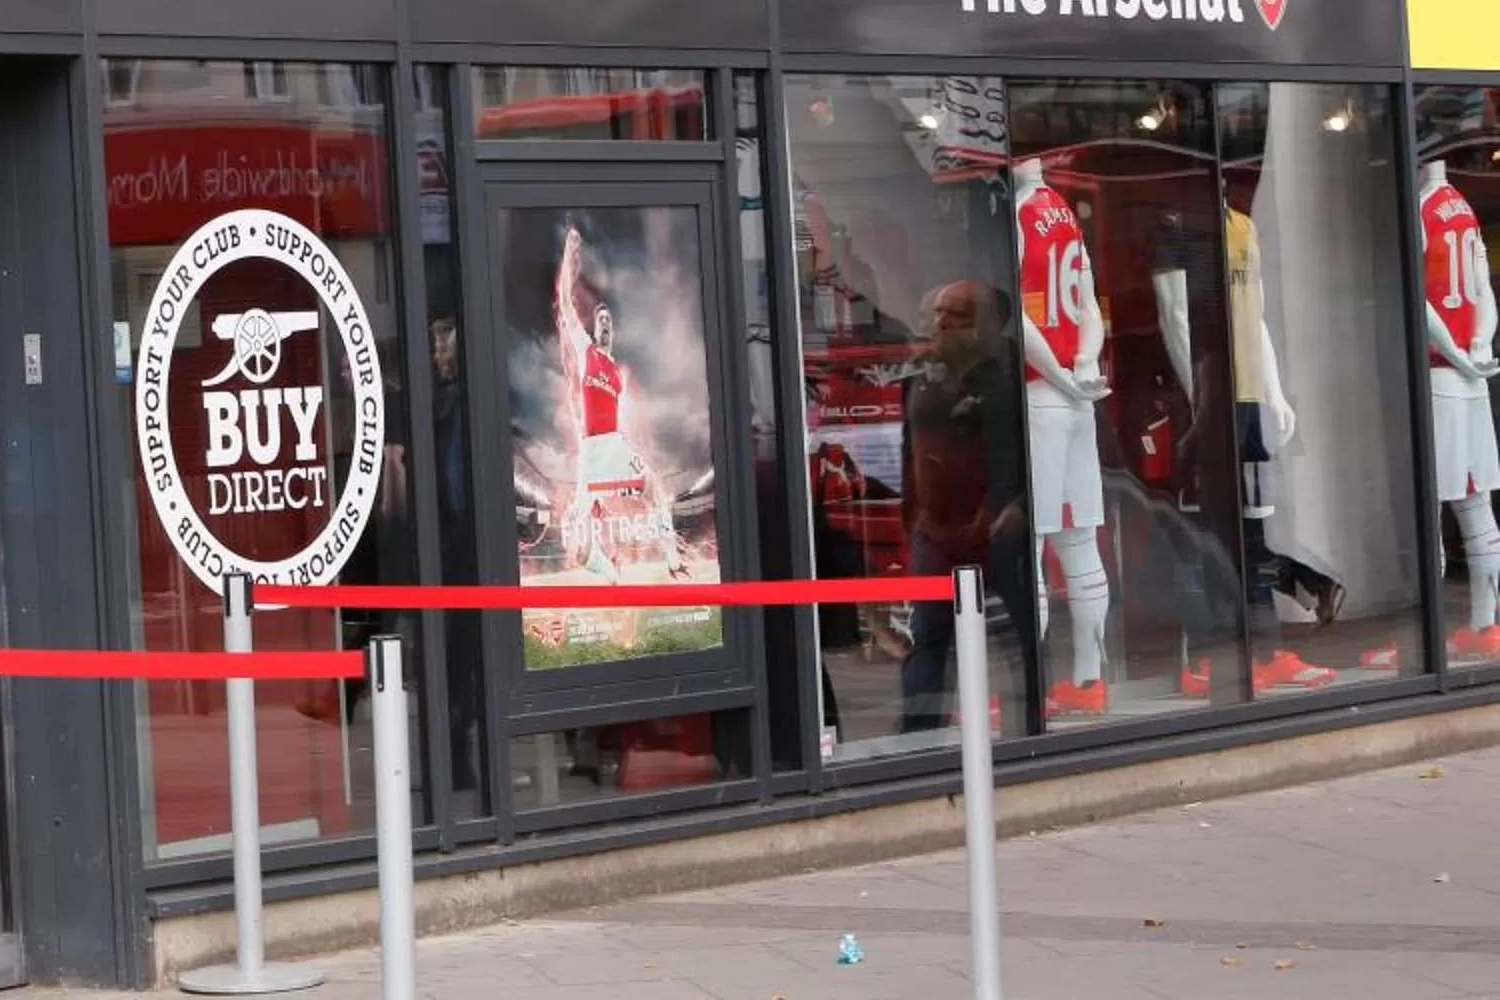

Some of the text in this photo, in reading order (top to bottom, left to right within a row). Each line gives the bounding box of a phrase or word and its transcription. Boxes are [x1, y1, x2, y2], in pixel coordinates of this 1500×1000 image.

[1046, 239, 1083, 328] 16
[143, 224, 241, 493] SUPPORT YOUR CLUB
[265, 223, 378, 476] SUPPORT YOUR CLUB
[202, 386, 323, 467] BUY
[208, 466, 327, 517] DIRECT
[178, 517, 224, 577] CLUB
